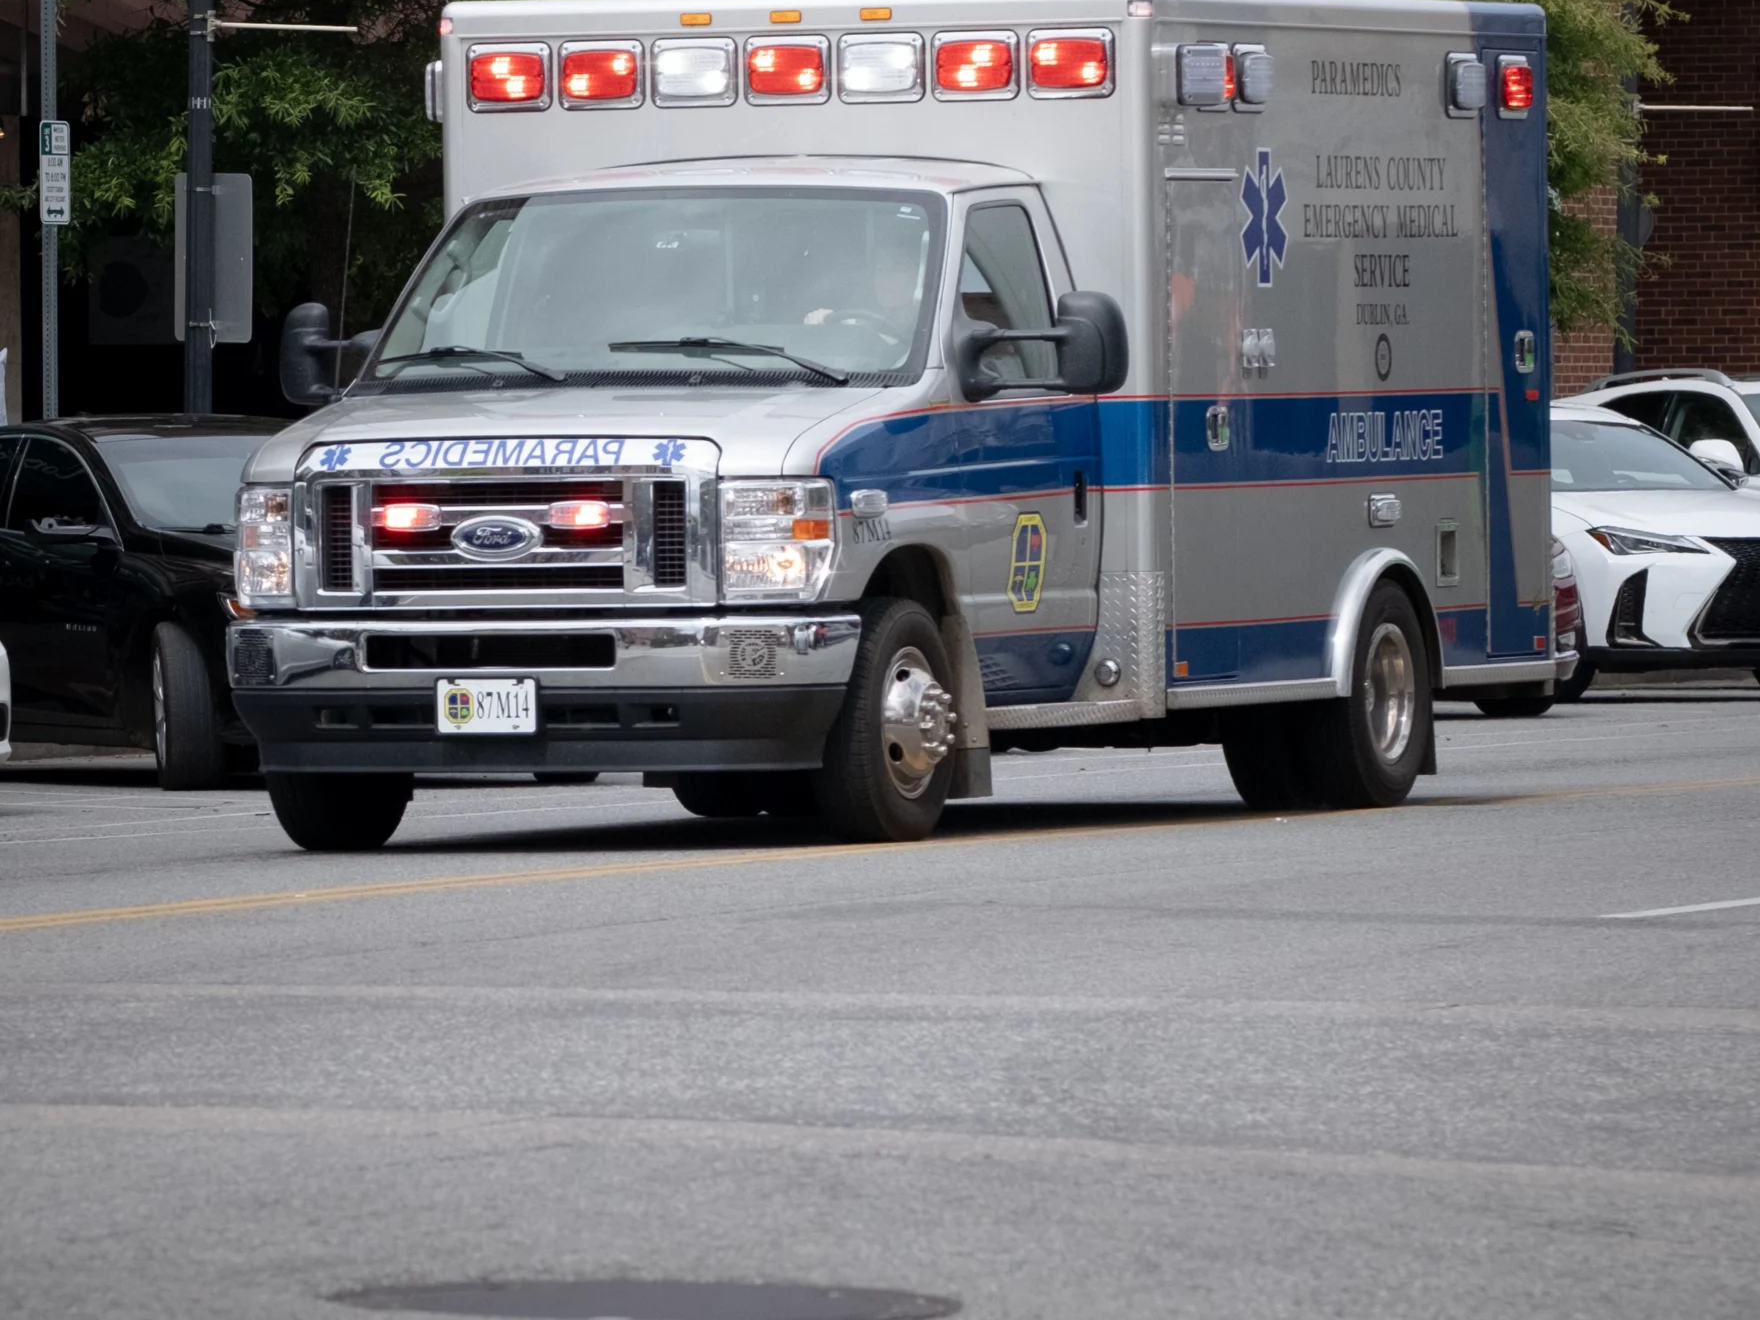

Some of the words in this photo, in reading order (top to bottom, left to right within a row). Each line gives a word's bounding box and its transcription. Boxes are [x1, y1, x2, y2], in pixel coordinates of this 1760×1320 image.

[1310, 60, 1402, 97] PARAMEDICS
[1315, 155, 1381, 190] LAURENS
[1386, 157, 1446, 191] COUNTY
[1303, 204, 1390, 238] EMERGENCY
[1396, 204, 1458, 238] MEDICAL
[1354, 254, 1410, 288] SERVICE
[1356, 303, 1394, 328] DUBLIN,
[1394, 303, 1410, 325] GA.
[1326, 409, 1444, 463] AMBULANCE
[472, 526, 512, 545] Ford
[852, 518, 892, 545] 87M14
[476, 691, 529, 719] 87M14
